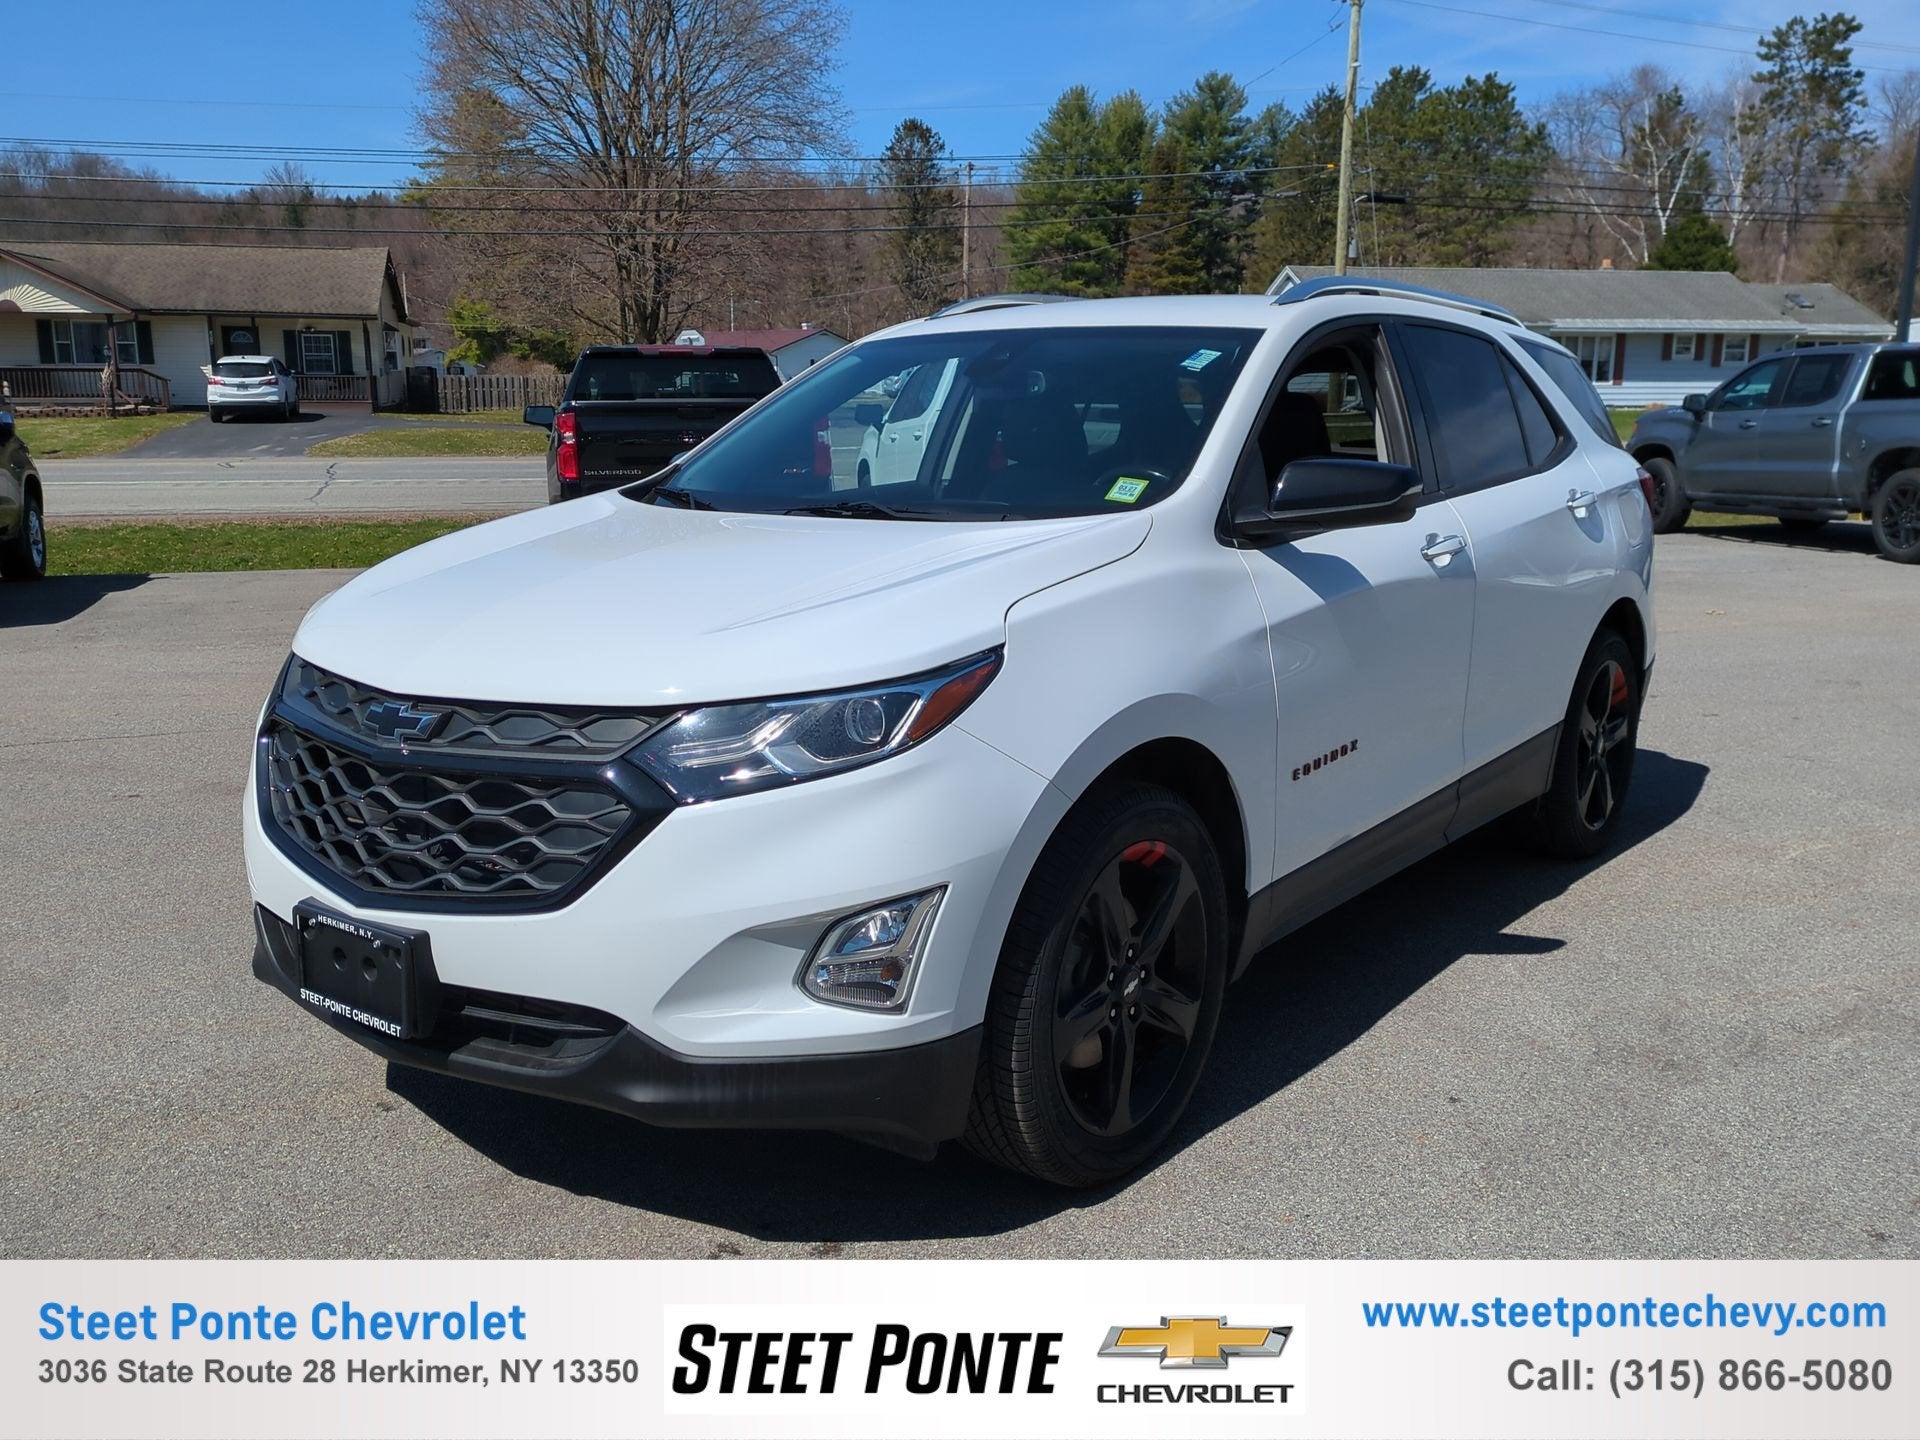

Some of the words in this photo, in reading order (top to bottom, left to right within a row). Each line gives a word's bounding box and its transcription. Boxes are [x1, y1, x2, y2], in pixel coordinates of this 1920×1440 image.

[584, 468, 642, 476] SILVERADO
[1291, 738, 1358, 781] EQUINOX
[317, 914, 358, 935] HERKIMER,
[359, 928, 374, 940] N.Y.
[300, 988, 351, 1018] STEET-PONTE
[352, 1009, 401, 1037] CHEVROLET
